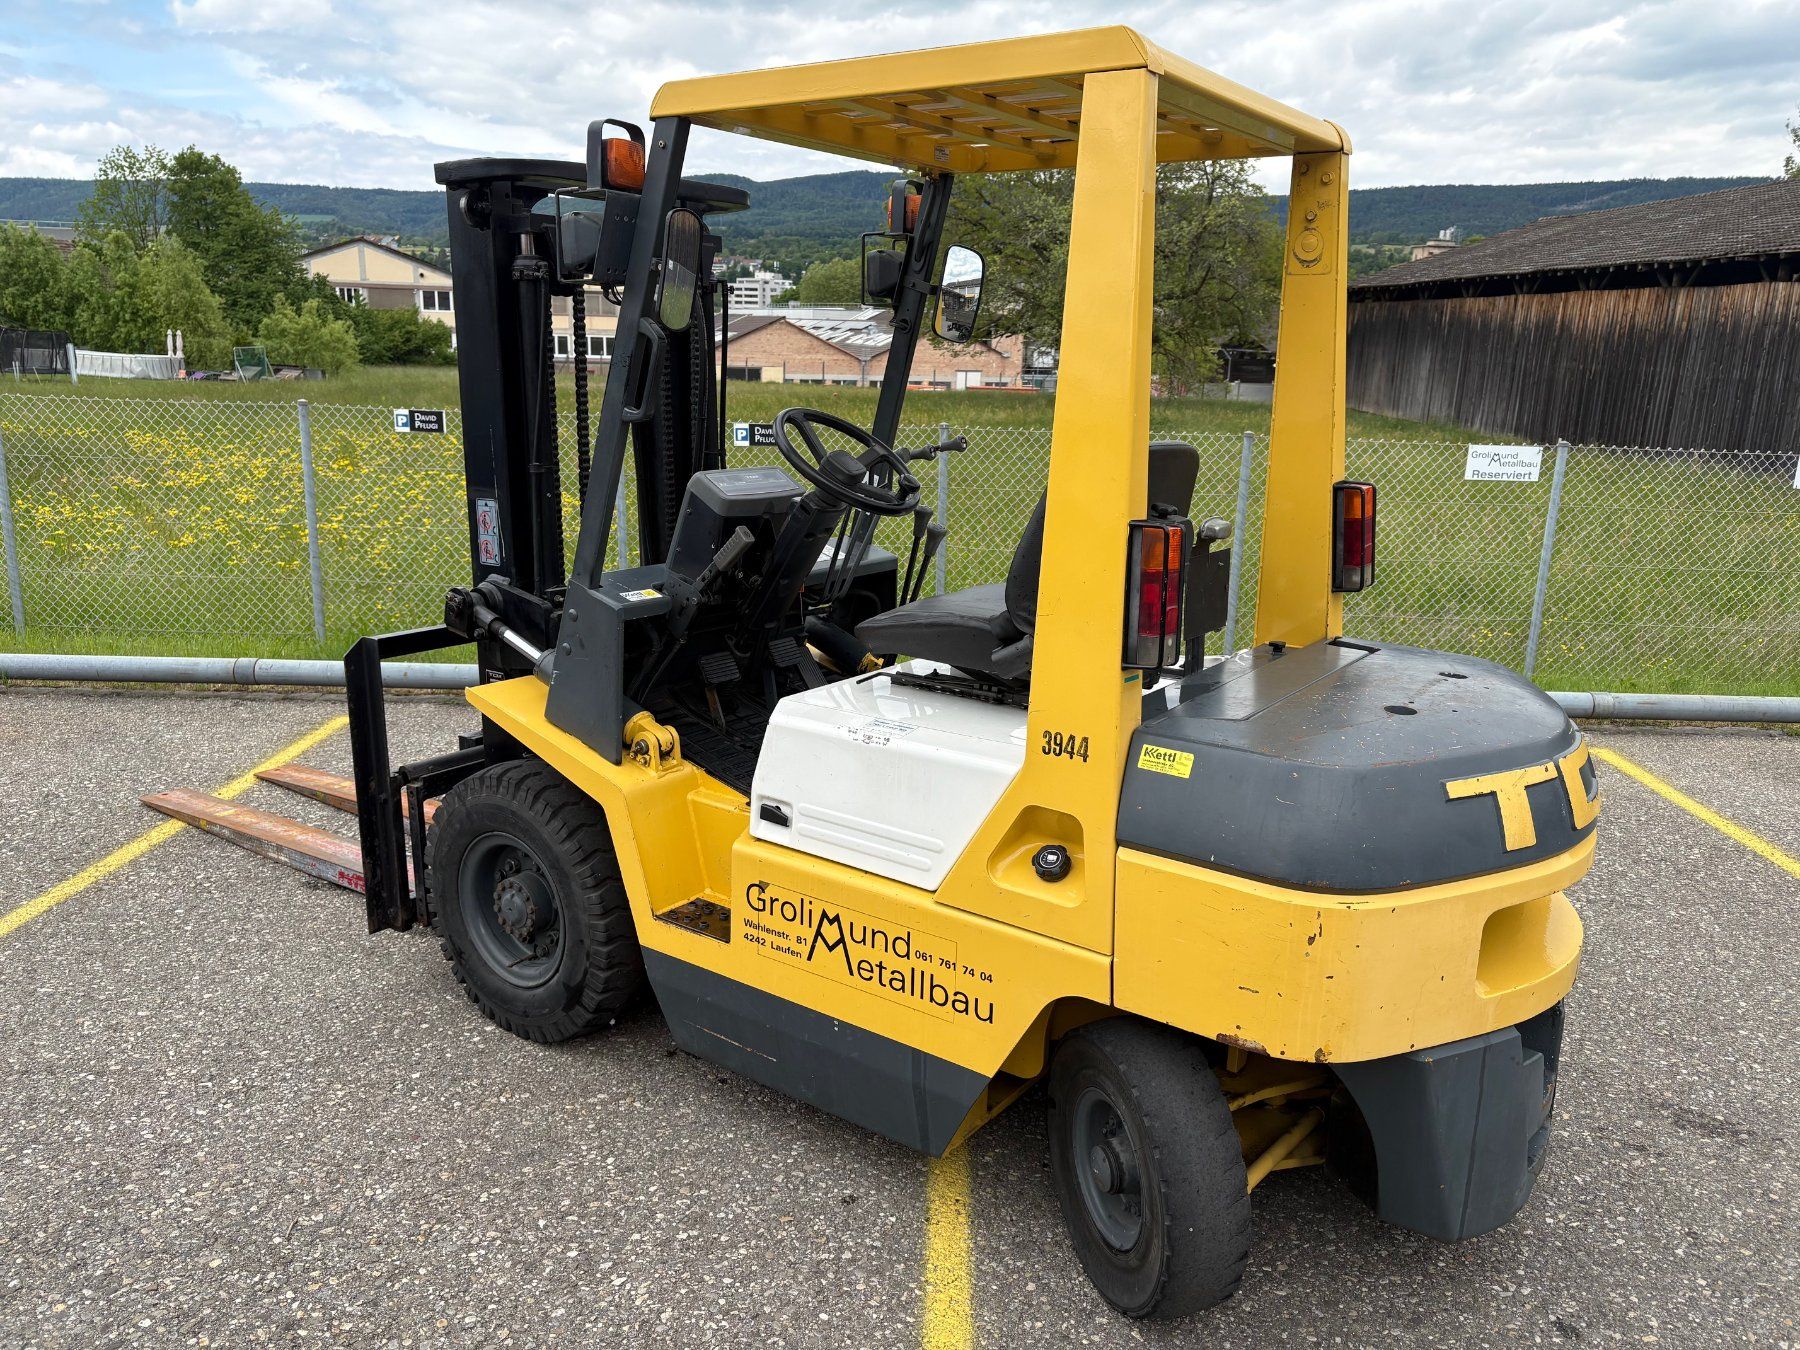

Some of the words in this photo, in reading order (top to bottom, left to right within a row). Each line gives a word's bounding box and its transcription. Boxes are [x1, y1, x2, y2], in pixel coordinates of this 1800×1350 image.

[754, 426, 773, 434] DAVI
[754, 435, 776, 443] PFLUG
[1471, 469, 1532, 480] Reserviert
[1042, 730, 1090, 763] 3944
[743, 917, 792, 941] Wahlenstr.
[796, 935, 807, 947] 81
[743, 932, 767, 947] 4242
[770, 940, 802, 959] Laufen
[914, 949, 933, 964] 061
[938, 957, 957, 972] 761
[962, 965, 975, 978] 74
[980, 971, 993, 984] 04
